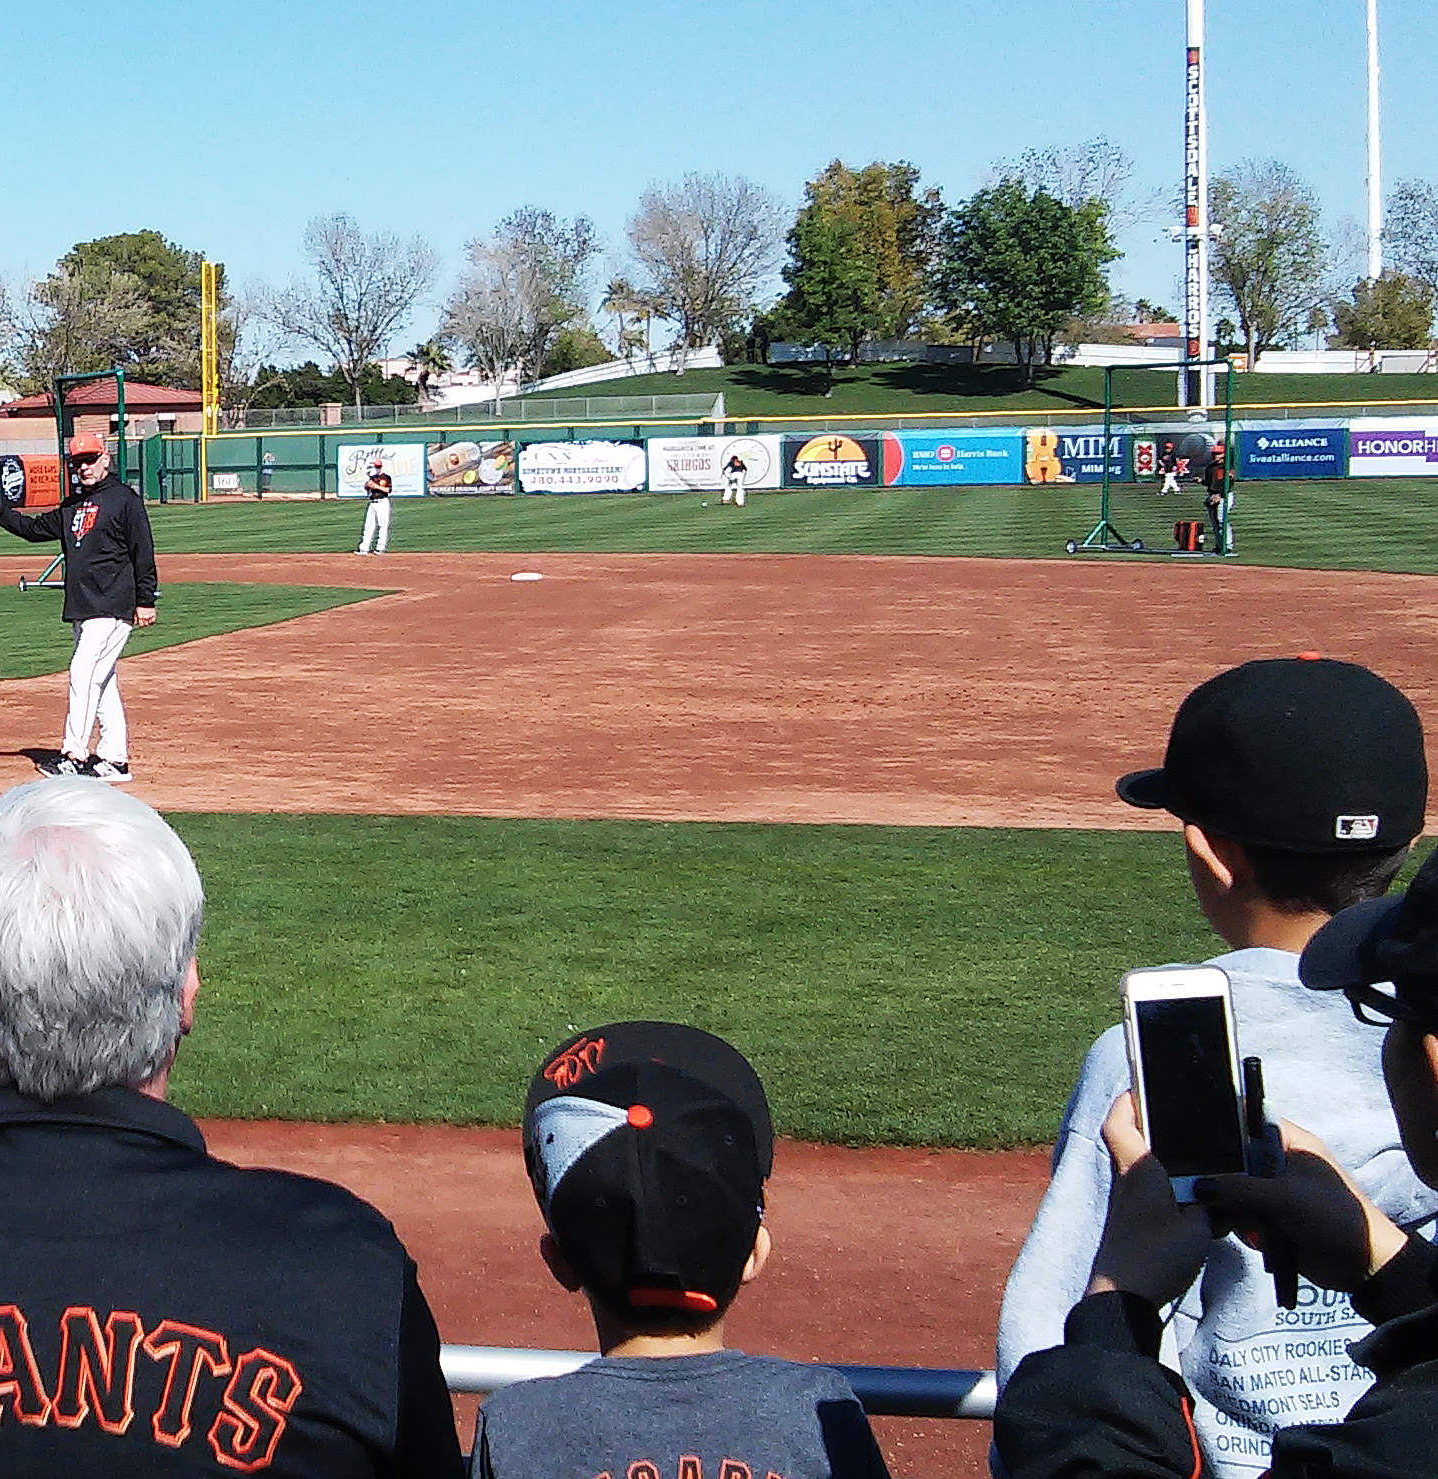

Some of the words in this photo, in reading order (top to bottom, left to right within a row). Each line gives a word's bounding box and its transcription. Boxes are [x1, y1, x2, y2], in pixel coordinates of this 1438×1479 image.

[1187, 64, 1199, 207] SCOTTSDALE
[1187, 240, 1200, 337] HARROS
[1062, 437, 1123, 458] MIM
[1270, 438, 1328, 448] ALLIANCE
[1358, 440, 1438, 453] HONORH
[1249, 453, 1335, 463] liveatalliance.com
[792, 461, 870, 479] SUNSTATE
[1275, 1310, 1337, 1327] SOUTH
[1208, 1345, 1249, 1369] DALY
[1250, 1343, 1282, 1365] CITY
[1209, 1369, 1245, 1392] SAN
[1250, 1368, 1296, 1392] MATEO
[1214, 1388, 1297, 1416] PIEDMONT
[1299, 1391, 1341, 1411] SEALS
